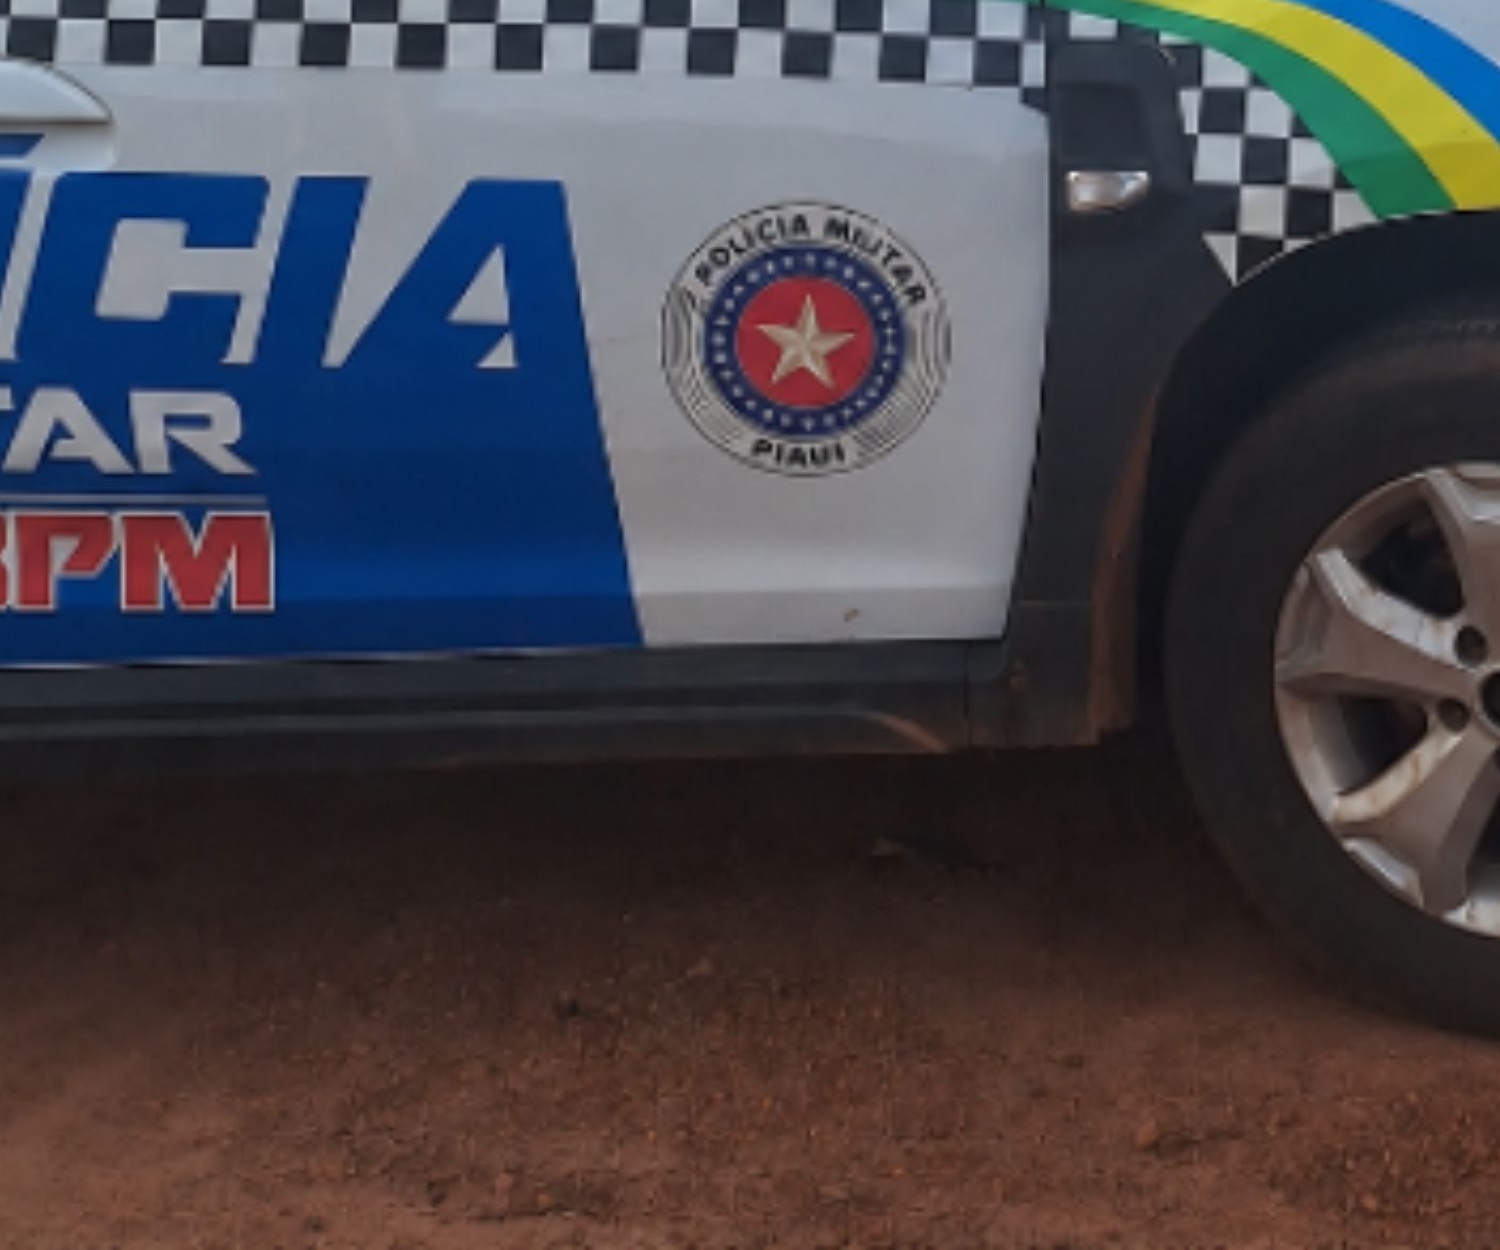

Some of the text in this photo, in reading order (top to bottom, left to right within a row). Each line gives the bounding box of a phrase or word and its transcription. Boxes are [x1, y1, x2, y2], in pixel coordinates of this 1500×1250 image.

[0, 133, 598, 368] CIA
[823, 217, 927, 305] MILITAR
[0, 386, 258, 474] AR
[0, 511, 275, 612] PM
